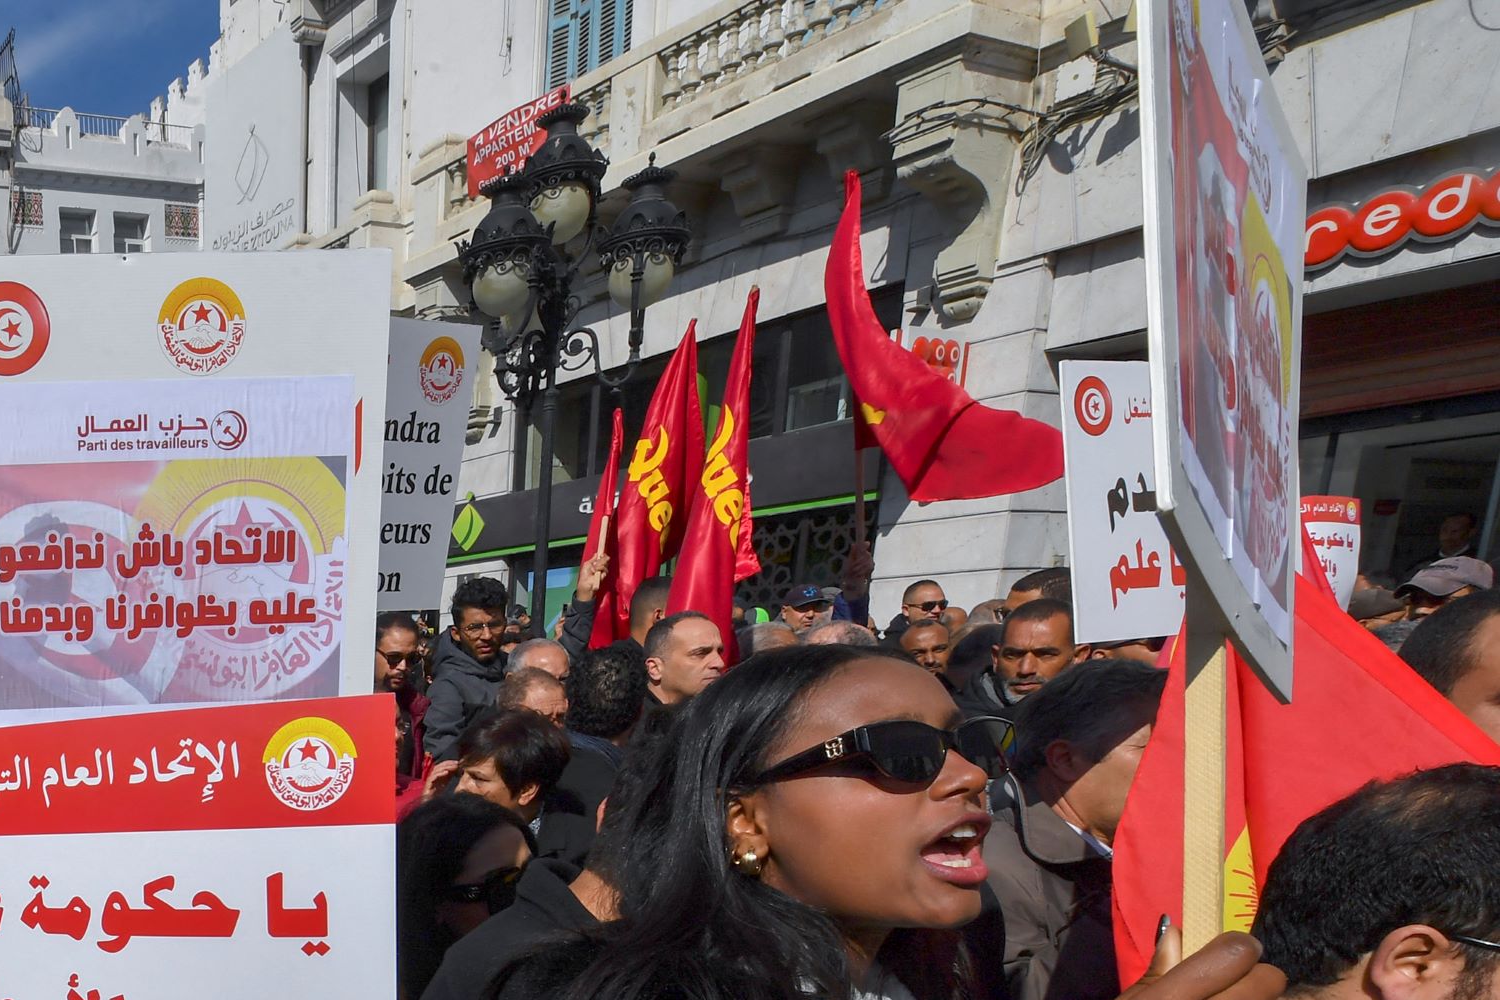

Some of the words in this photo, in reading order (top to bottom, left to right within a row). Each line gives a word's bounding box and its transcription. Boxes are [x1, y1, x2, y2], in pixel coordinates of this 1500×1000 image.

[488, 88, 561, 141] VENDRE
[495, 150, 516, 170] 200
[1304, 172, 1500, 254] red
[77, 413, 148, 438] العمال
[77, 439, 108, 451] Parti
[110, 438, 134, 450] des
[136, 436, 209, 450] travailleurs
[158, 414, 209, 437] حزب
[384, 410, 442, 445] ndra
[380, 462, 417, 495] its
[423, 464, 454, 496] de
[116, 521, 184, 579] باش
[195, 527, 297, 566] الاتحاد
[379, 521, 432, 546] eurs
[1109, 537, 1162, 611] علم
[105, 592, 238, 641] بظوافرنا
[248, 591, 317, 635] عليه
[41, 748, 113, 808] العام
[129, 739, 240, 804] الإتحاد
[20, 874, 241, 955] حكومة
[265, 871, 332, 957] يا
